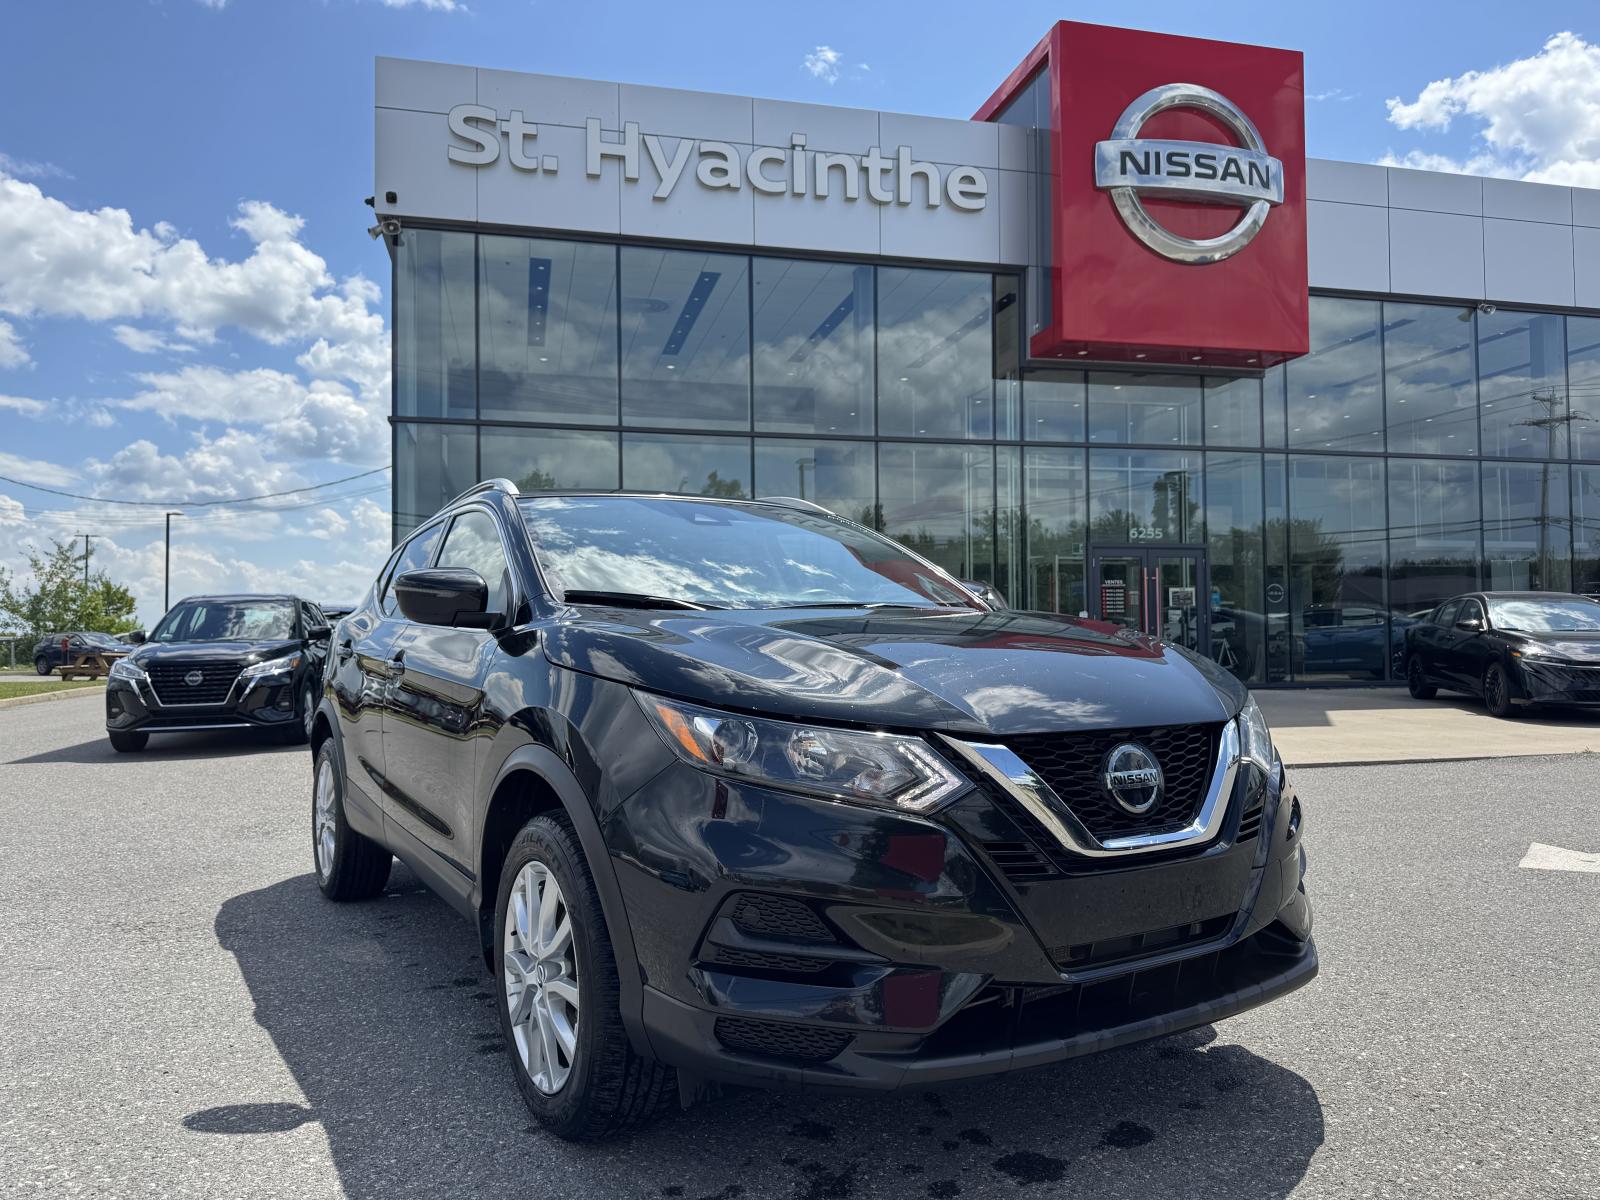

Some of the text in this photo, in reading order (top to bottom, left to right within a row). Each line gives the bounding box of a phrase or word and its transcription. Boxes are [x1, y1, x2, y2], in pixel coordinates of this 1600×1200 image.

[448, 104, 988, 211] St. Hyacinthe
[1120, 151, 1270, 190] NISSAN
[1129, 528, 1163, 539] 6255
[1113, 773, 1157, 786] NISSAN
